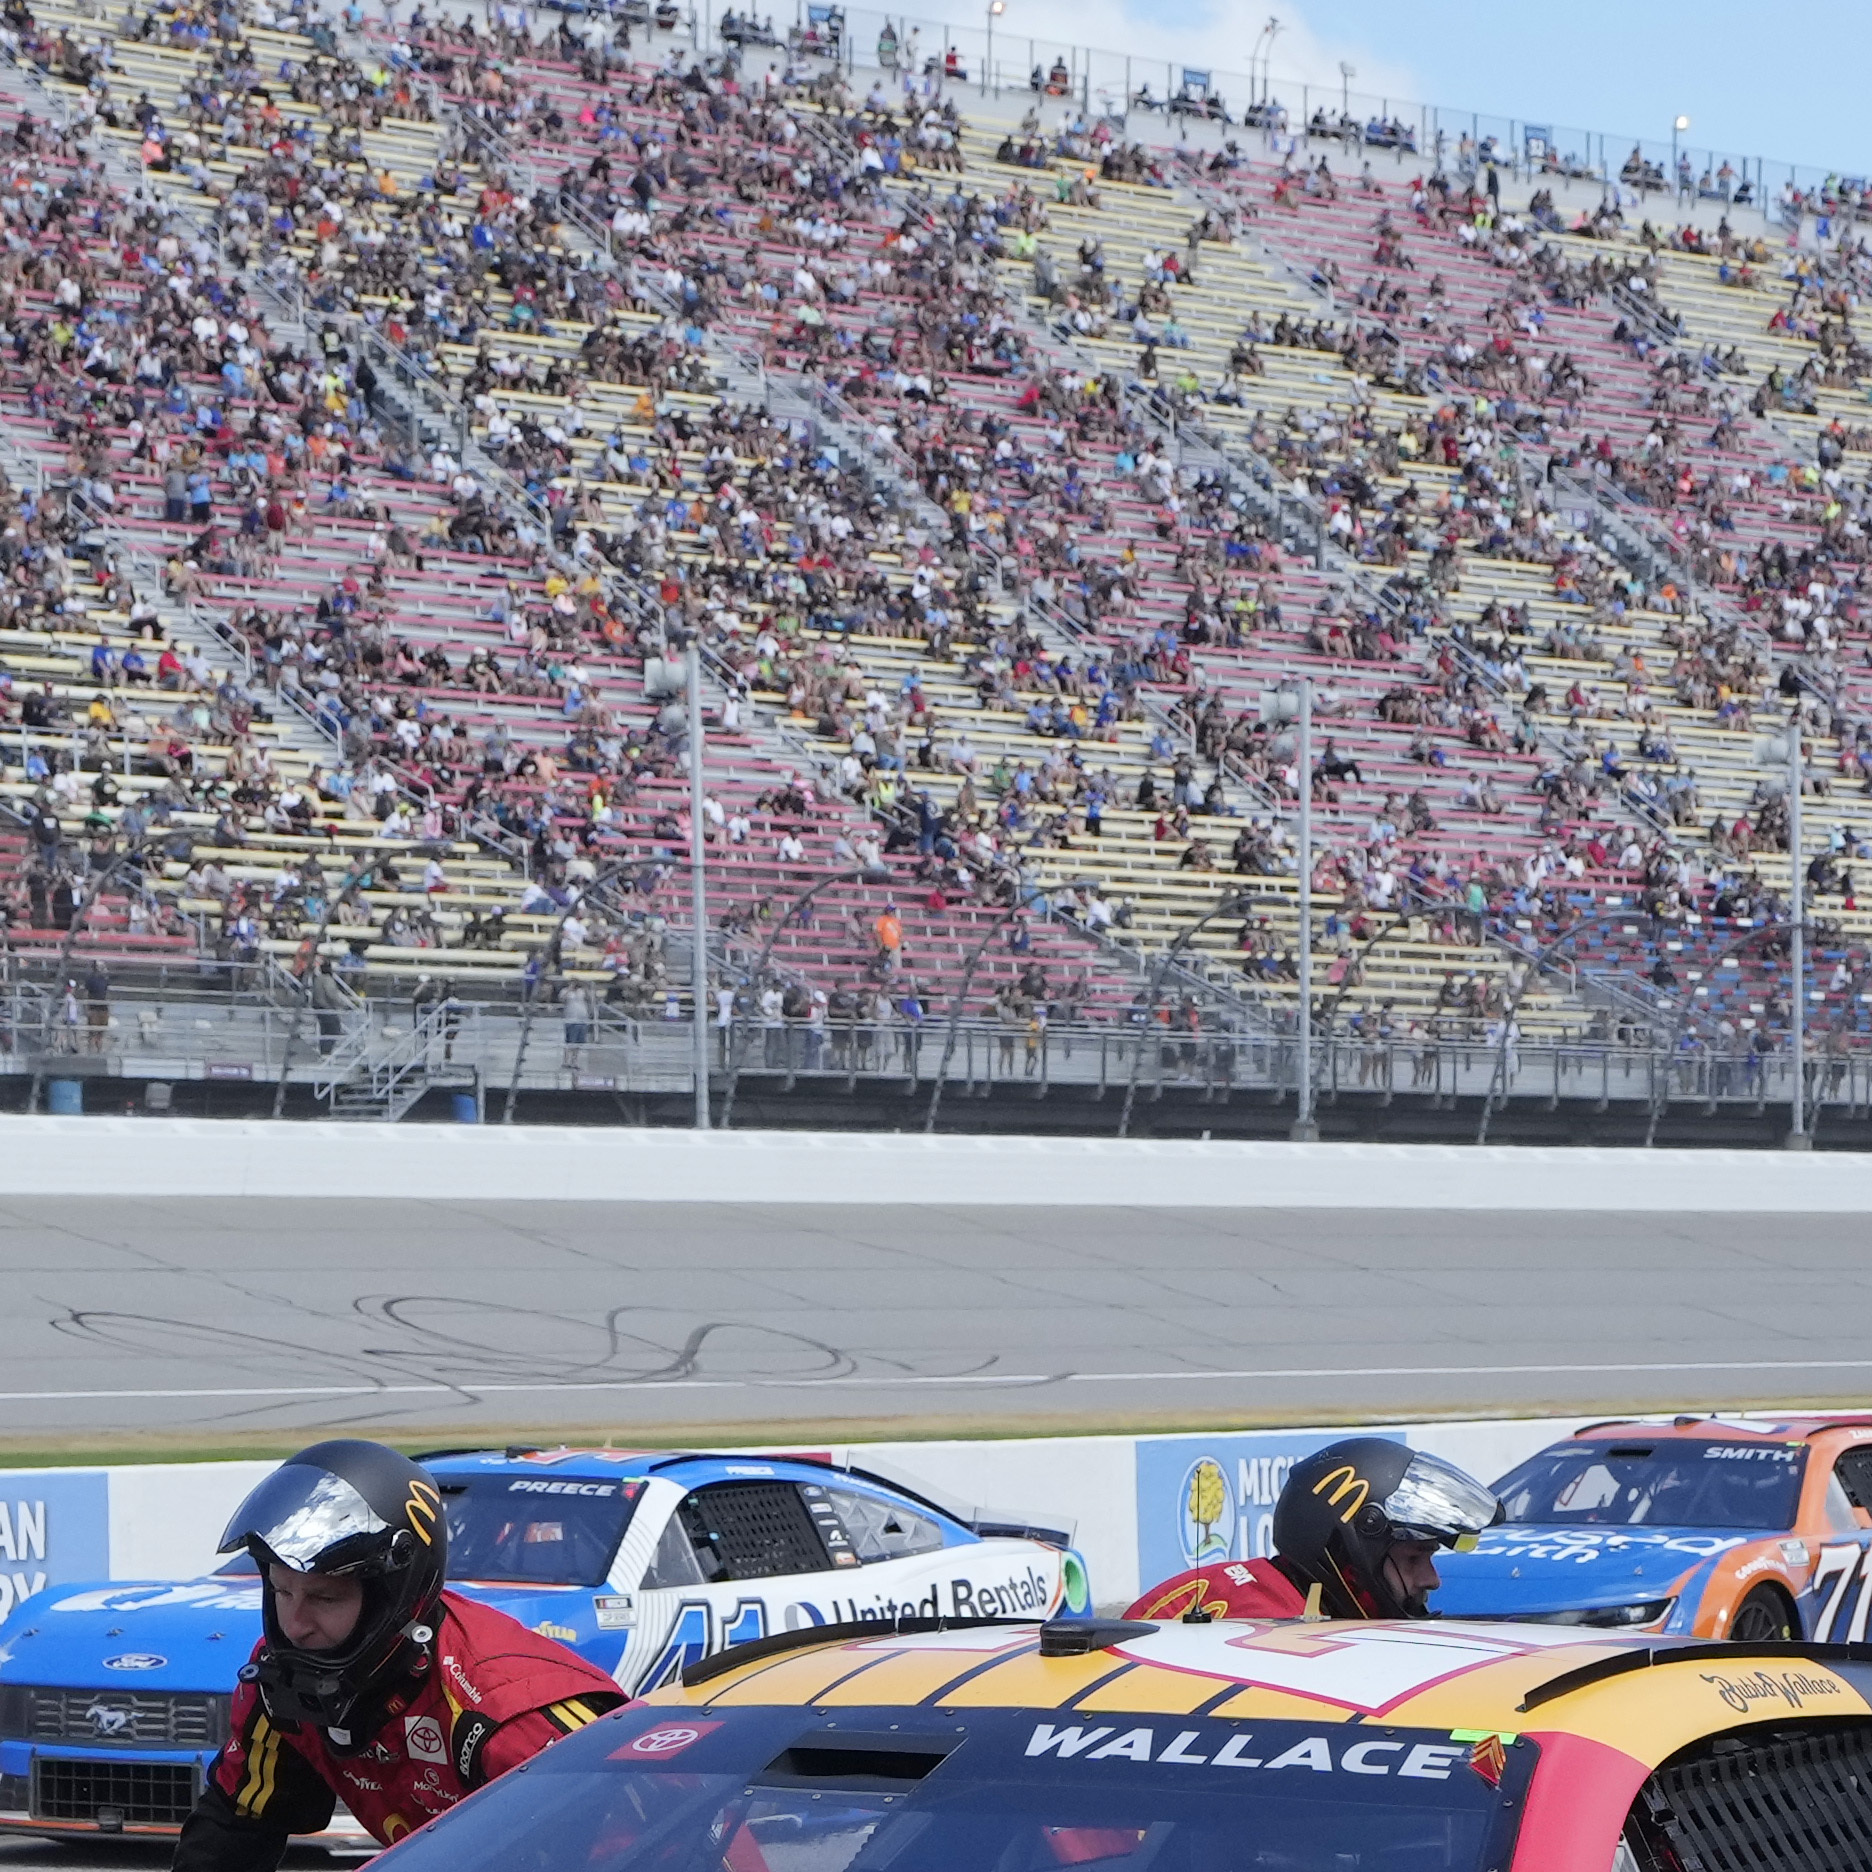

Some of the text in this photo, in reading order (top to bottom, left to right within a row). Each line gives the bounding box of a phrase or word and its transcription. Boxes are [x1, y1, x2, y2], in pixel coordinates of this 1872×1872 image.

[1703, 1446, 1795, 1463] SMITH
[509, 1480, 616, 1497] PREECE
[951, 1565, 1048, 1619] Rentals
[449, 1662, 483, 1704] Columbia
[1754, 1671, 1841, 1709] Wallace
[459, 1722, 485, 1780] sparco
[1024, 1722, 1471, 1780] WALLACE
